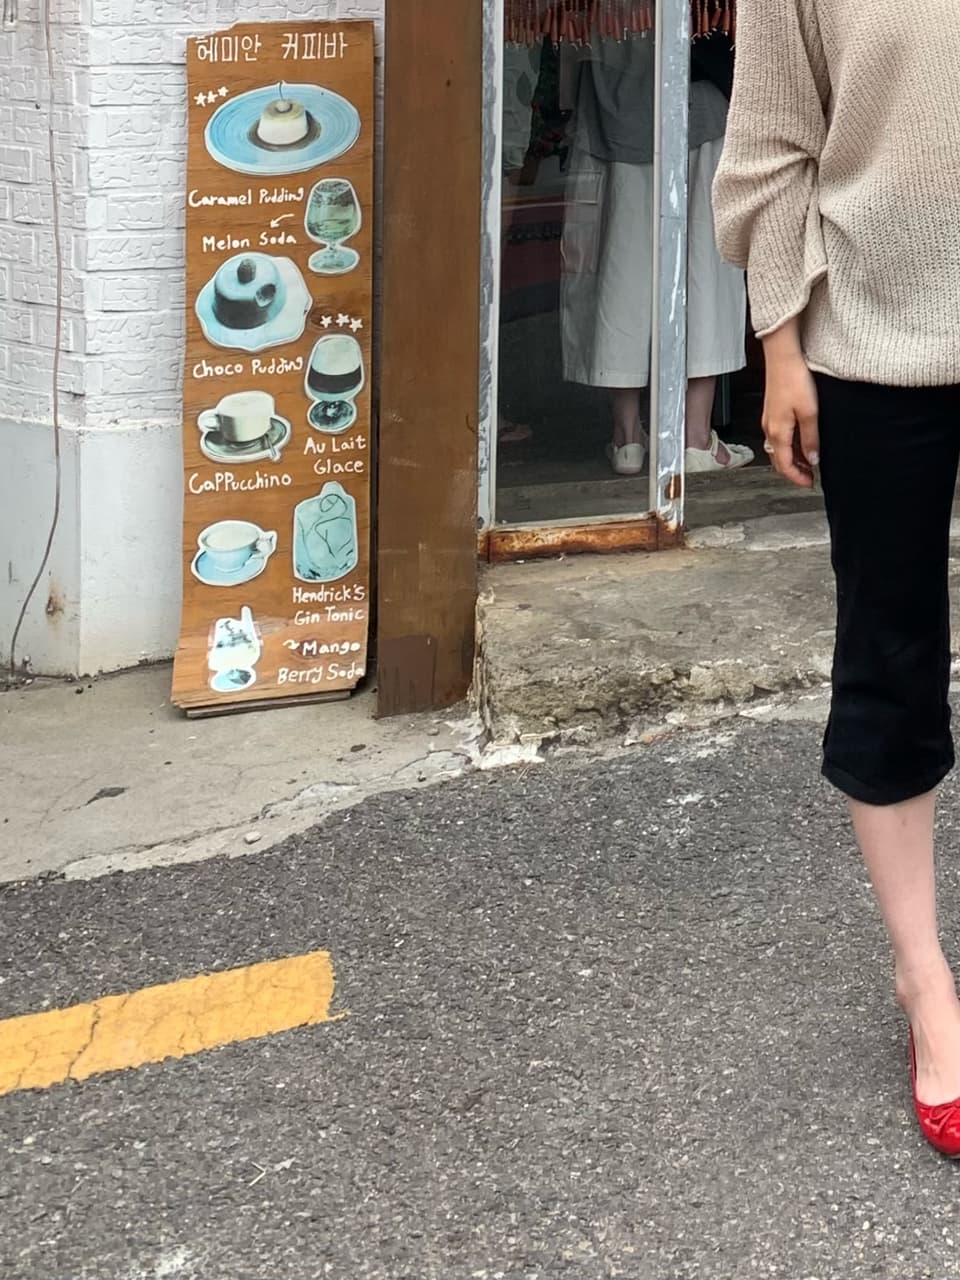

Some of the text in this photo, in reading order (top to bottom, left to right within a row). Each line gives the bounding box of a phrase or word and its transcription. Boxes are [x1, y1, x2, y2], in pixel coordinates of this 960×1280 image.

[195, 32, 348, 62] 헤미안 커피바
[188, 187, 304, 208] Caramel Pudding
[202, 231, 297, 252] Melon Soda
[252, 356, 304, 375] Pudding
[303, 434, 366, 455] Au Lait
[313, 458, 364, 475] Glace
[294, 606, 365, 626] Gin Tonic
[302, 639, 361, 656] Mango
[277, 663, 365, 685] Berry Soda
